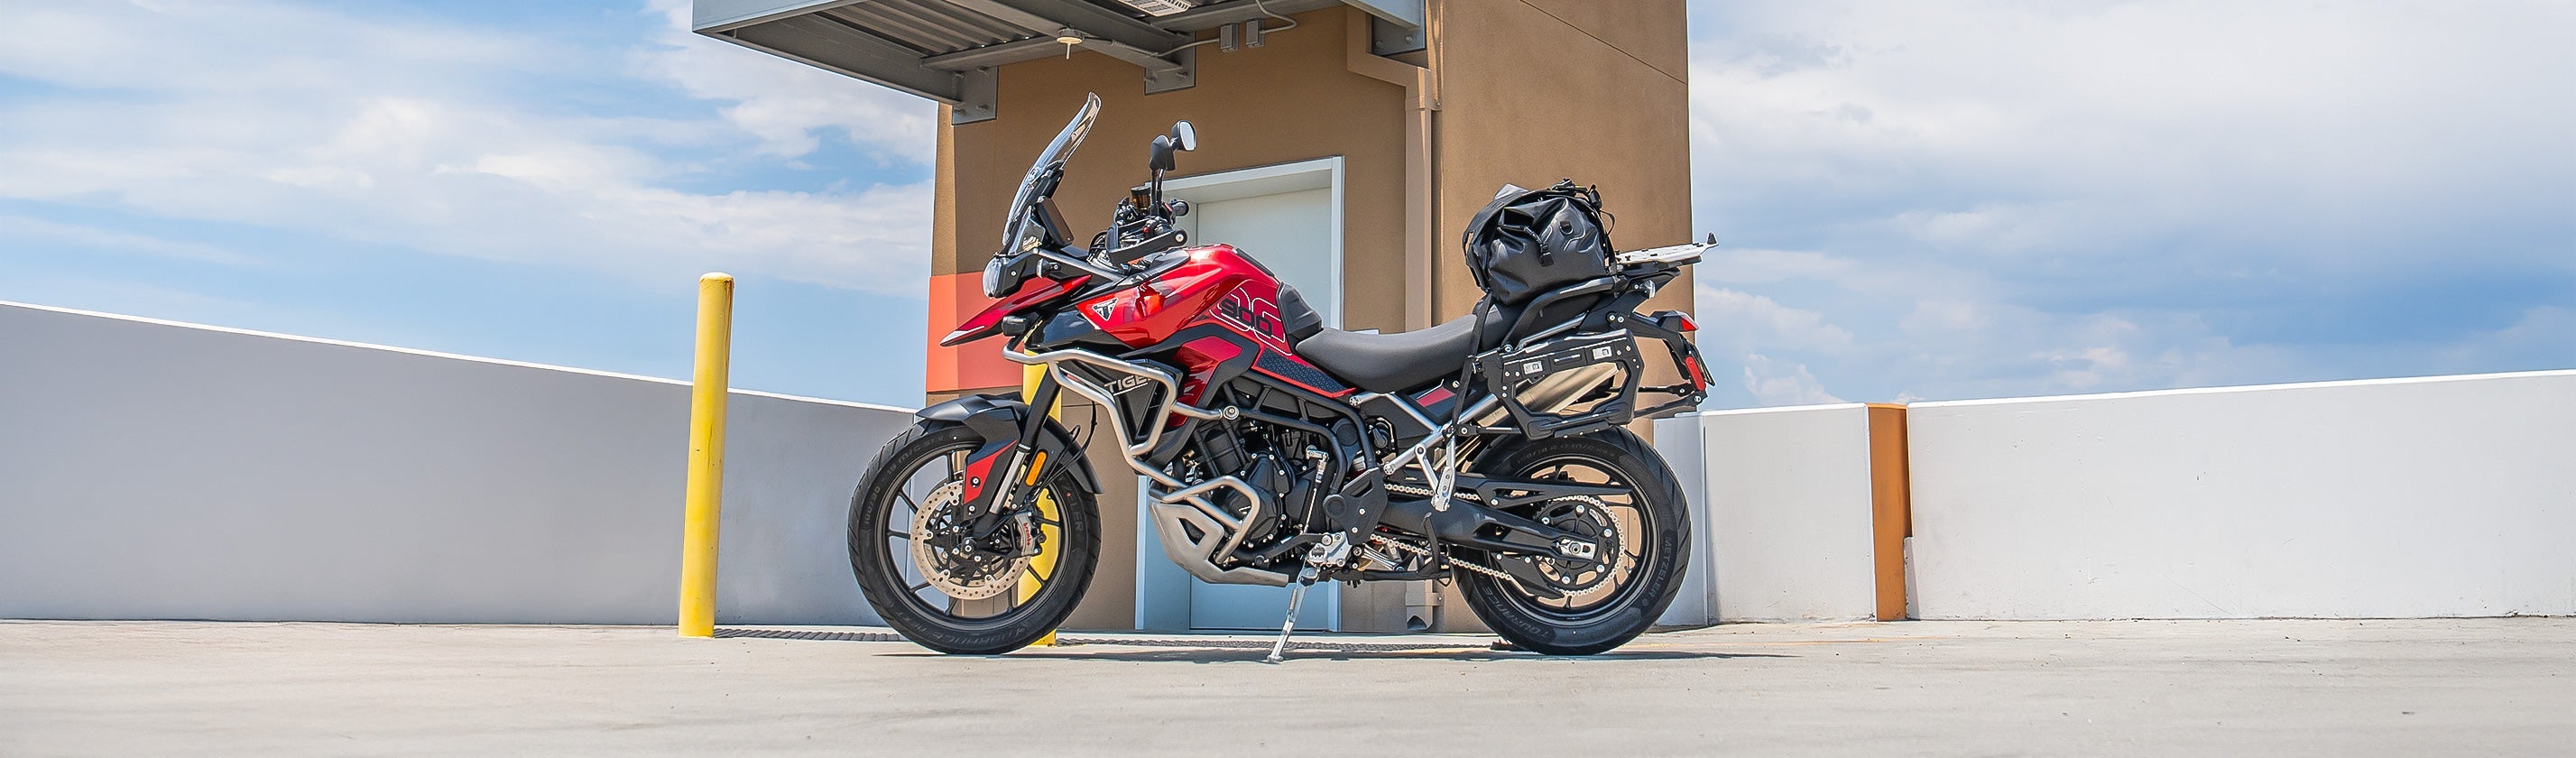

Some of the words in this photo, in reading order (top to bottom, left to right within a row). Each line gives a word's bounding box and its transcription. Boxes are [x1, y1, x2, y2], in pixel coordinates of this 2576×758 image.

[1221, 298, 1272, 337] 900
[1104, 374, 1152, 393] TIGE
[1648, 537, 1672, 597] METZELER
[1482, 586, 1549, 637] TOURANCE
